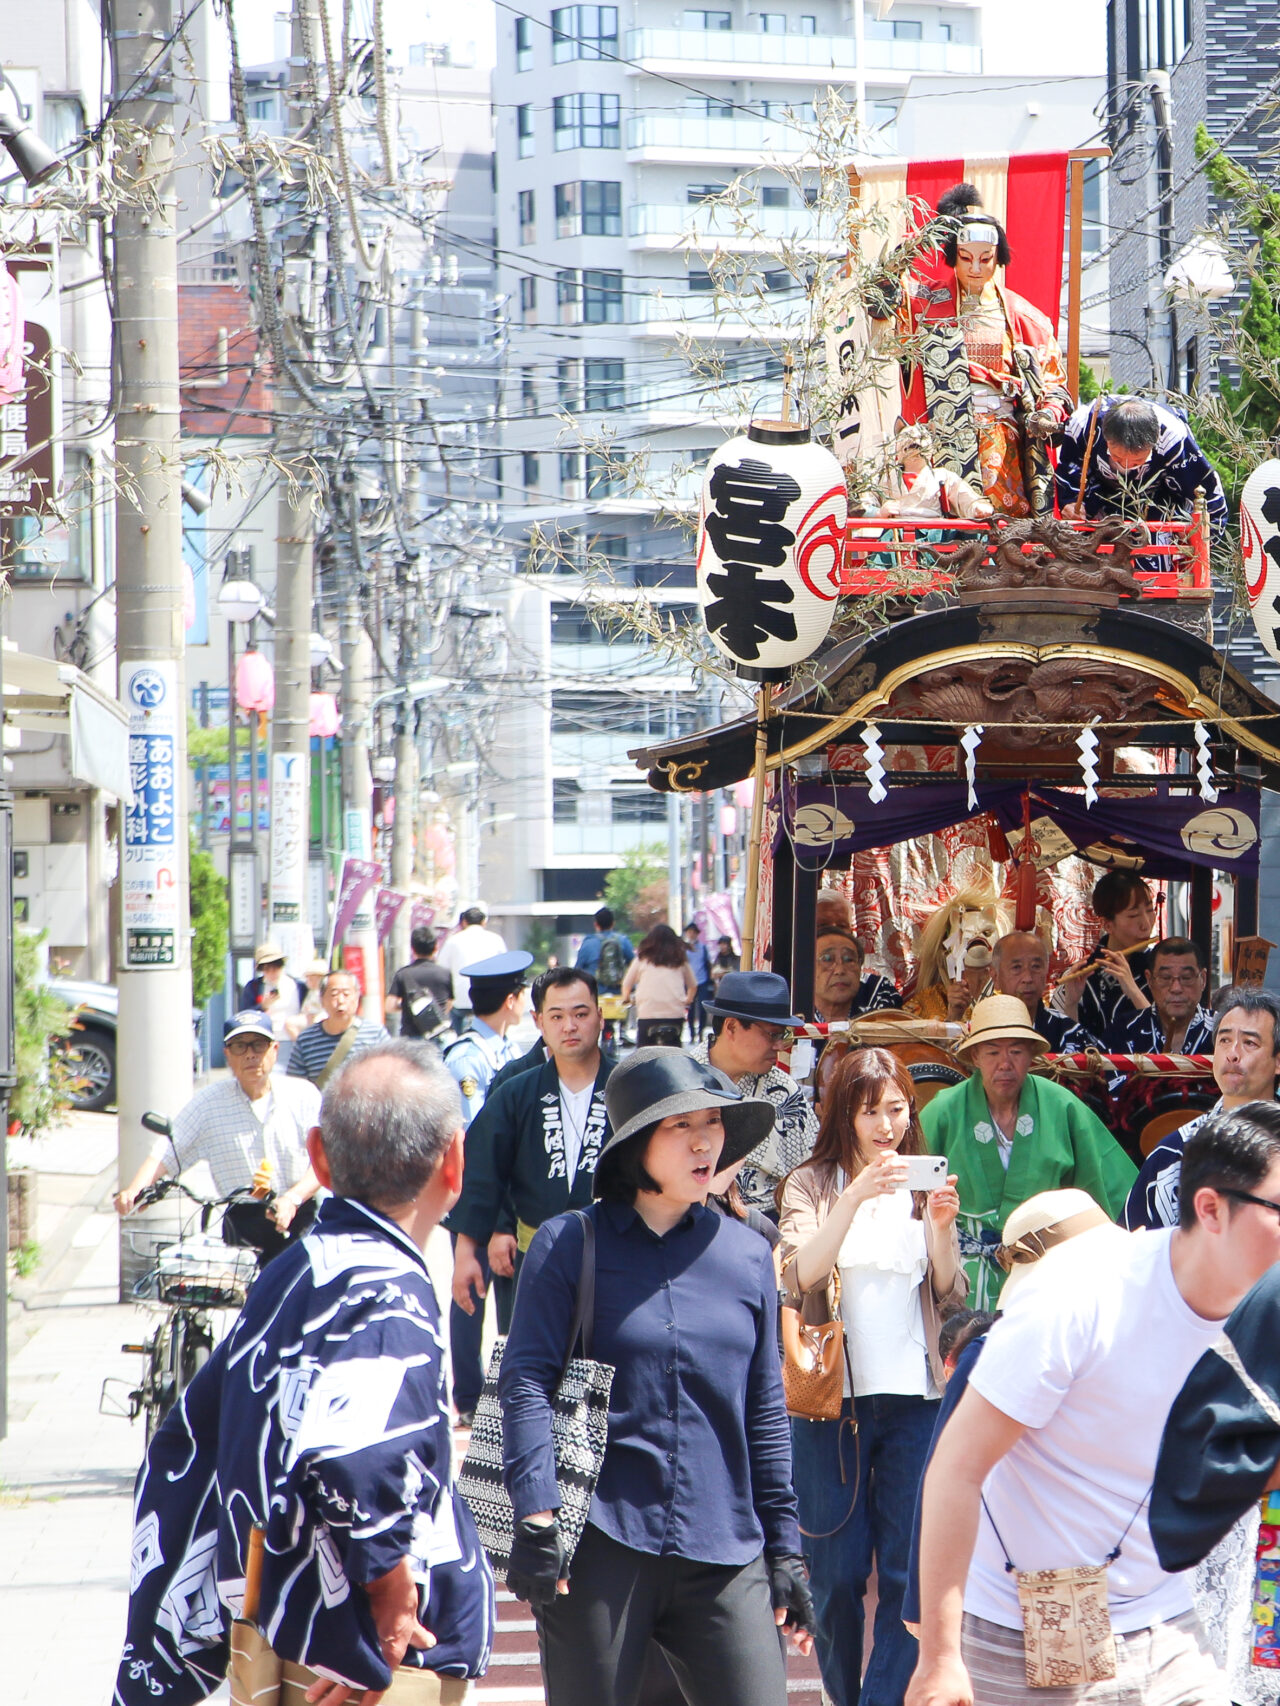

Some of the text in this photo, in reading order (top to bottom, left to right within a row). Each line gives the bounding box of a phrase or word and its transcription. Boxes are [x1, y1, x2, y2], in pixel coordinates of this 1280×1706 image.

[705, 458, 801, 660] 宮本
[125, 737, 148, 843] 整形外科
[149, 737, 173, 842] あおよこ
